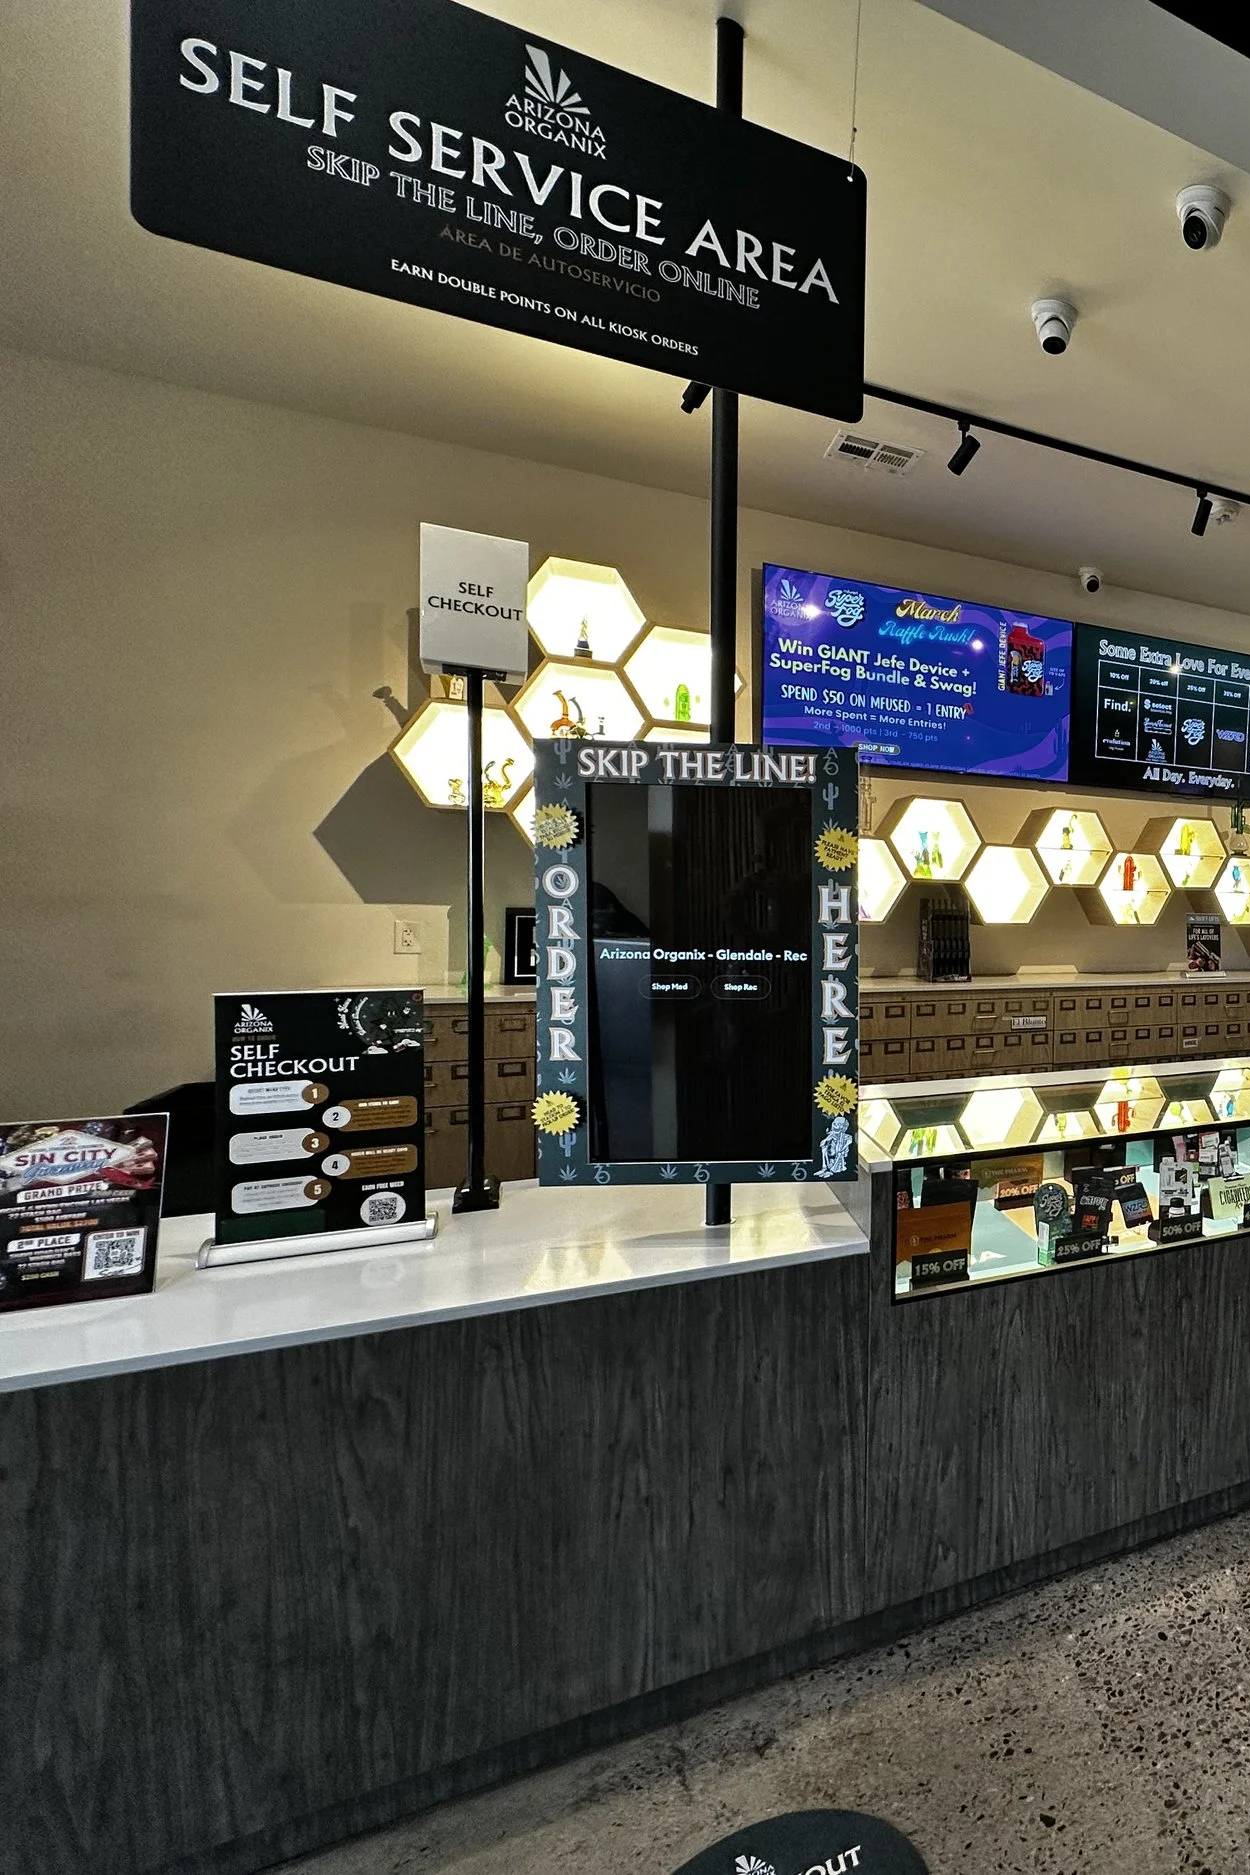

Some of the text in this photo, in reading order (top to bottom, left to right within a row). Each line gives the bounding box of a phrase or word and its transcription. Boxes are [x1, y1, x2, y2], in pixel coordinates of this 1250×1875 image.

[504, 94, 607, 142] ARIZONA
[504, 111, 607, 161] ORGANIX
[179, 37, 841, 305] SELF SERVICE AREA
[306, 145, 761, 310] SKIP THE LINE, ORDER ONLINE
[499, 241, 522, 262] DE
[527, 253, 661, 304] AUTOSERVICIO
[391, 258, 699, 356] EARN DOUBLE POINTS ON ALL KIOSK ORDERS
[458, 580, 494, 599] SELF
[427, 595, 524, 621] CHECKOUT
[895, 597, 962, 623] March
[878, 619, 975, 646] Raffle Rush!
[778, 637, 958, 678] Win GIANT Jefe Device
[1098, 639, 1137, 661] Some
[1139, 645, 1172, 667] Extra
[1175, 652, 1205, 673] Love
[1207, 658, 1229, 677] For
[769, 652, 977, 697] SuperFog Bundle Swag!
[780, 684, 967, 721] SPEND $50 ON MFUSED 1 ENTRY
[1103, 698, 1132, 713] Find.
[804, 705, 947, 731] More Spent More Entries!
[857, 743, 895, 753] SHOP NOW
[577, 748, 818, 784] SKIP THE LINE!
[1143, 766, 1235, 789] All Day. Everyday.
[542, 864, 582, 1063] ORDER
[599, 947, 808, 963] Arizona Organix Glendale Rec
[818, 883, 856, 1065] HERE
[651, 982, 689, 992] Shop Med
[724, 983, 758, 992] Shop Rec
[234, 1020, 274, 1028] ARIZONA
[234, 1026, 274, 1034] ORGANIX
[230, 1043, 280, 1061] SELF
[229, 1056, 360, 1078] CHECKOUT
[311, 1087, 319, 1099] 1
[332, 1112, 340, 1122] 2
[311, 1138, 320, 1149] 3
[15, 1153, 55, 1167] SIN
[64, 1147, 117, 1163] CITY
[331, 1160, 339, 1171] 4
[24, 1188, 63, 1201] GRAND
[68, 1183, 103, 1196] PRIZE
[314, 1184, 323, 1196] 5
[1162, 1220, 1202, 1237] 50% OFF
[1056, 1238, 1102, 1257] 25% OFF
[914, 1258, 966, 1277] 15% OFF
